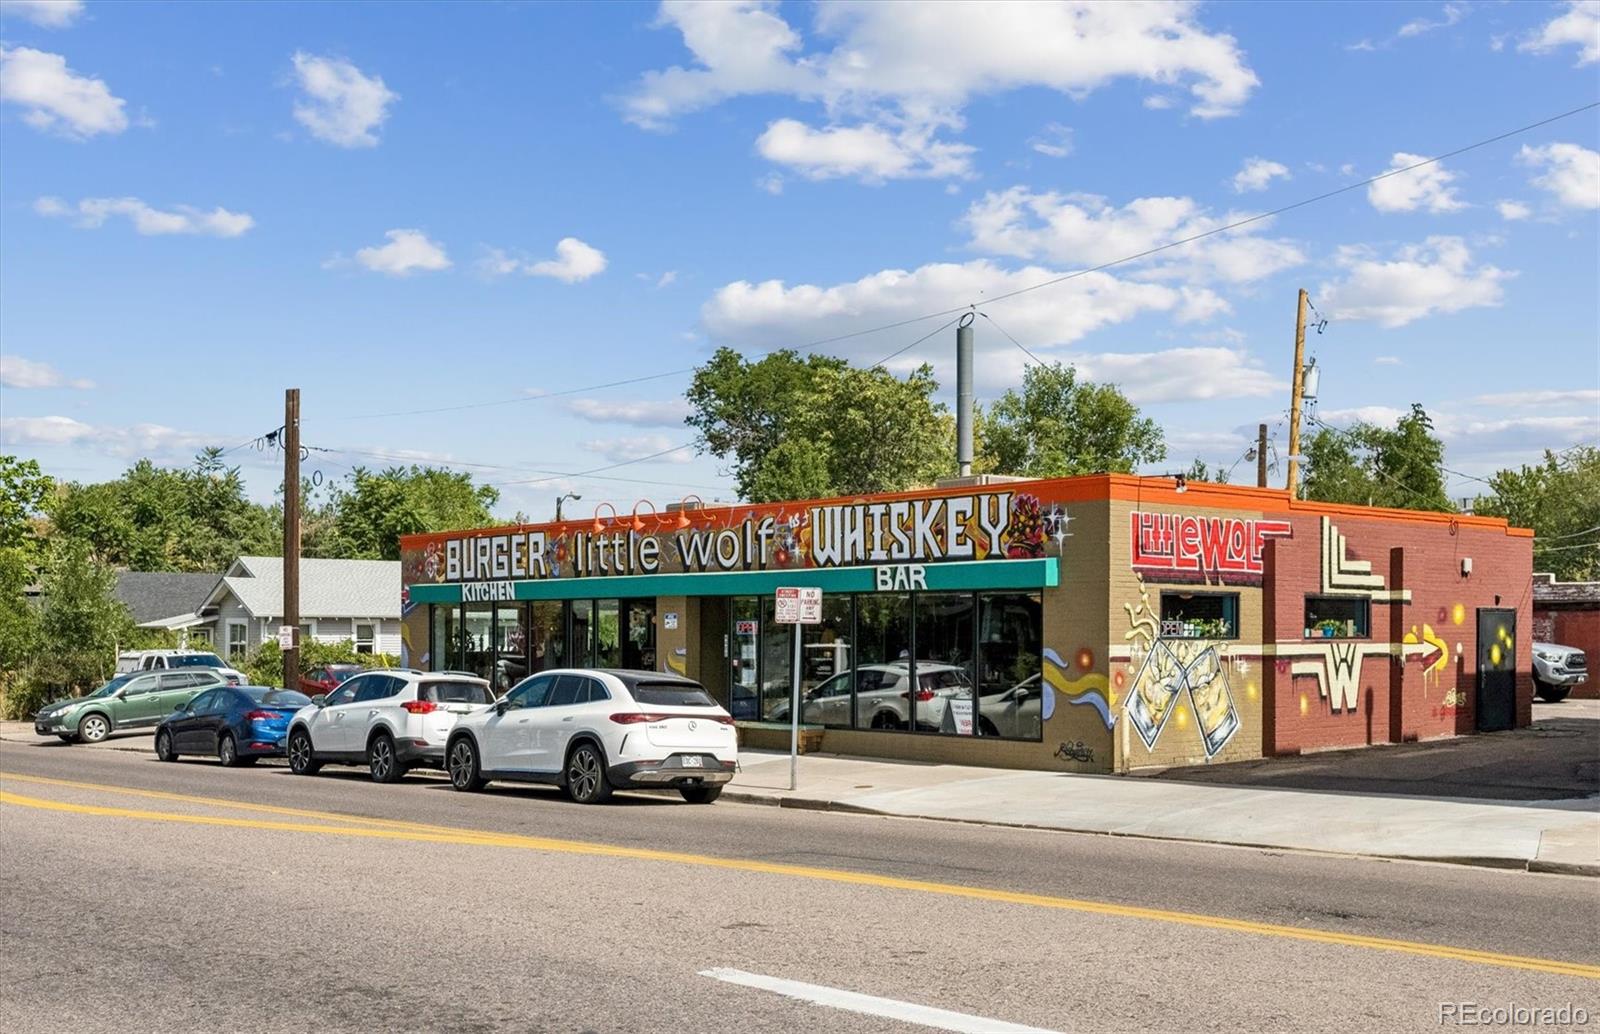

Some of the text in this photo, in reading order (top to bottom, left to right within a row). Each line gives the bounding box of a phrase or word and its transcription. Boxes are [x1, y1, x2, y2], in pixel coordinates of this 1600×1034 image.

[574, 516, 775, 573] little wolf
[810, 492, 1012, 567] WHISKEY
[445, 530, 547, 580] BURGER
[876, 566, 927, 592] BAR
[461, 581, 515, 601] KITCHEN
